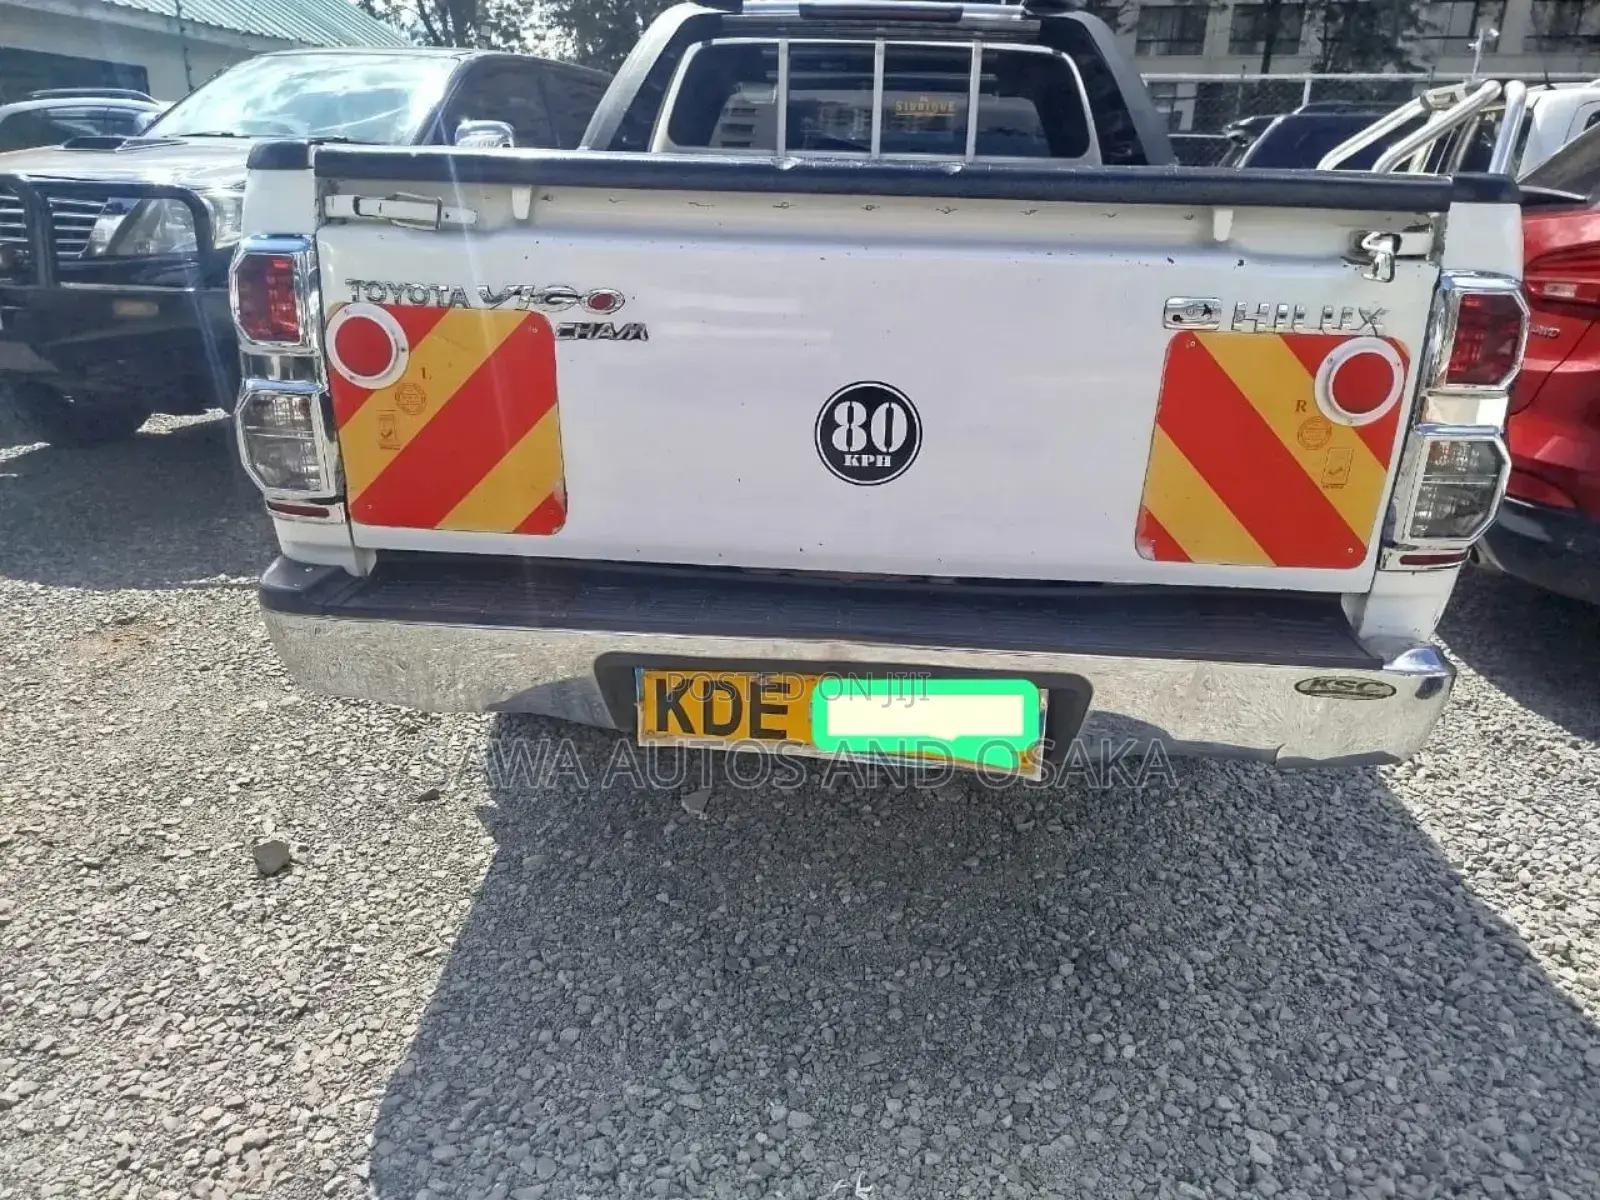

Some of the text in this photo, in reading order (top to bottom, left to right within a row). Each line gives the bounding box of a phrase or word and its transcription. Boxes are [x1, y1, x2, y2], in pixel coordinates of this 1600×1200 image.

[345, 279, 471, 309] TOYOTA
[1231, 301, 1388, 337] HILUX
[1295, 399, 1307, 413] R
[831, 400, 908, 453] 80
[844, 454, 892, 467] KPH
[655, 678, 790, 739] KDE
